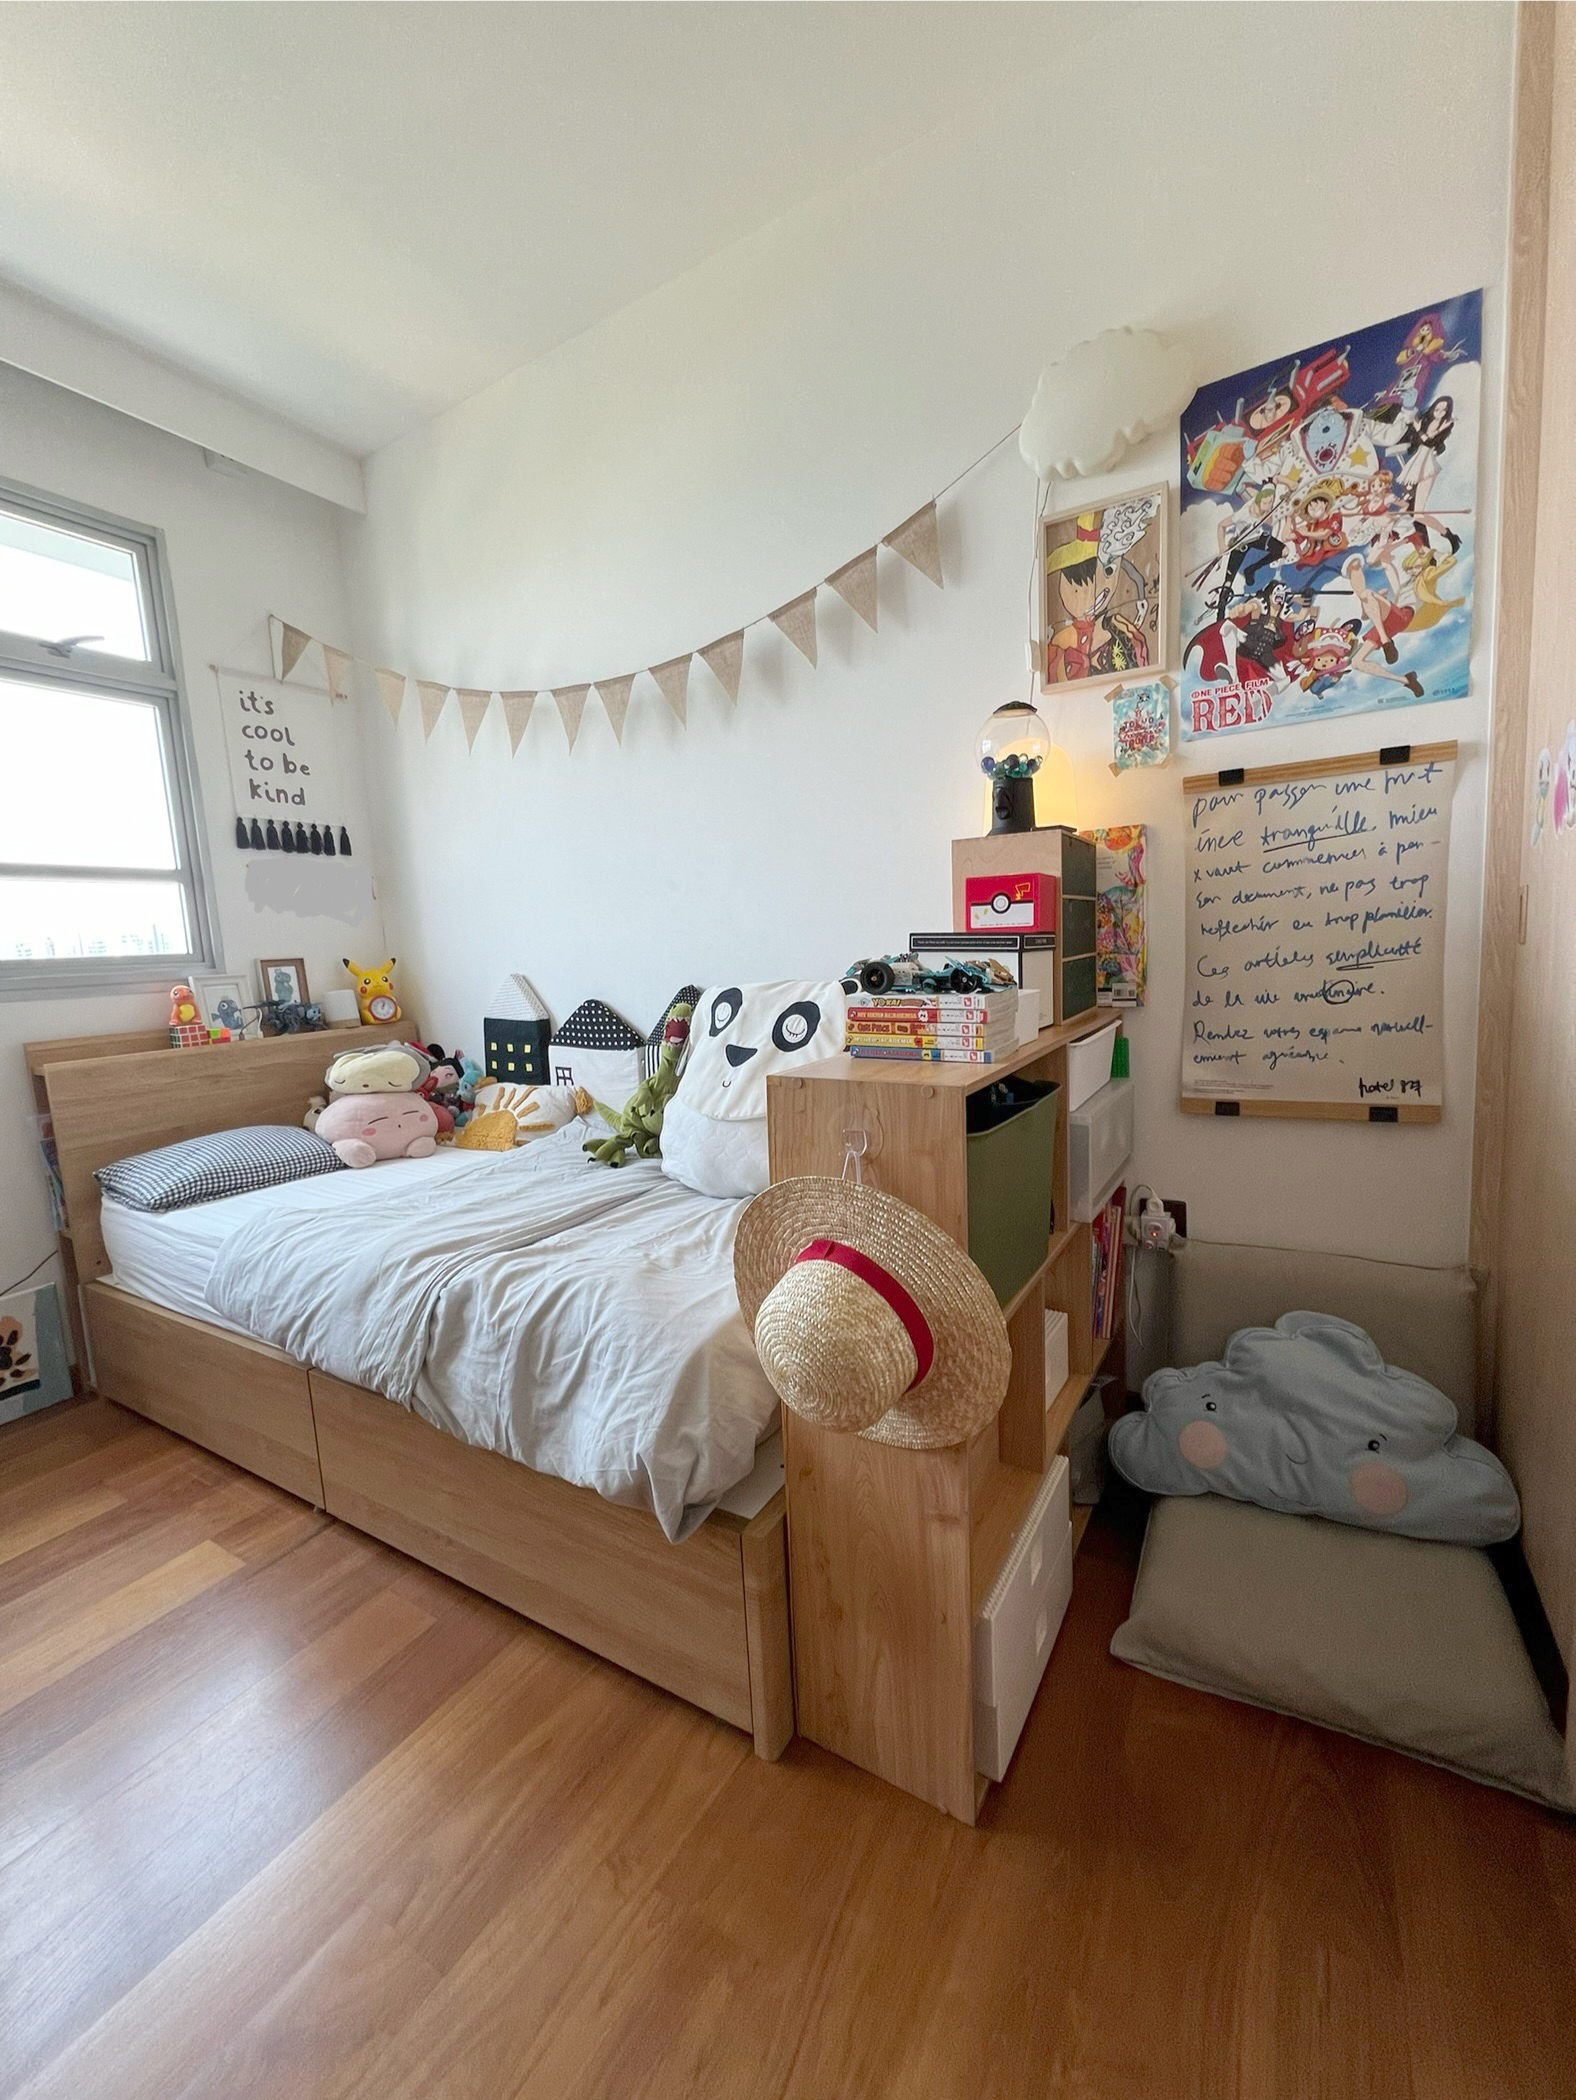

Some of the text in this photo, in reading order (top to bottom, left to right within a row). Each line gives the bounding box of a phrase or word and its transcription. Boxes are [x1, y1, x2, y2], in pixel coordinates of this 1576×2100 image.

[1190, 678, 1270, 700] ONE PIECE FILM
[1191, 689, 1273, 733] RED
[241, 725, 295, 747] cool
[244, 749, 311, 776] to be
[248, 778, 306, 806] kind
[1344, 877, 1377, 902] pas
[1389, 873, 1430, 899] trop
